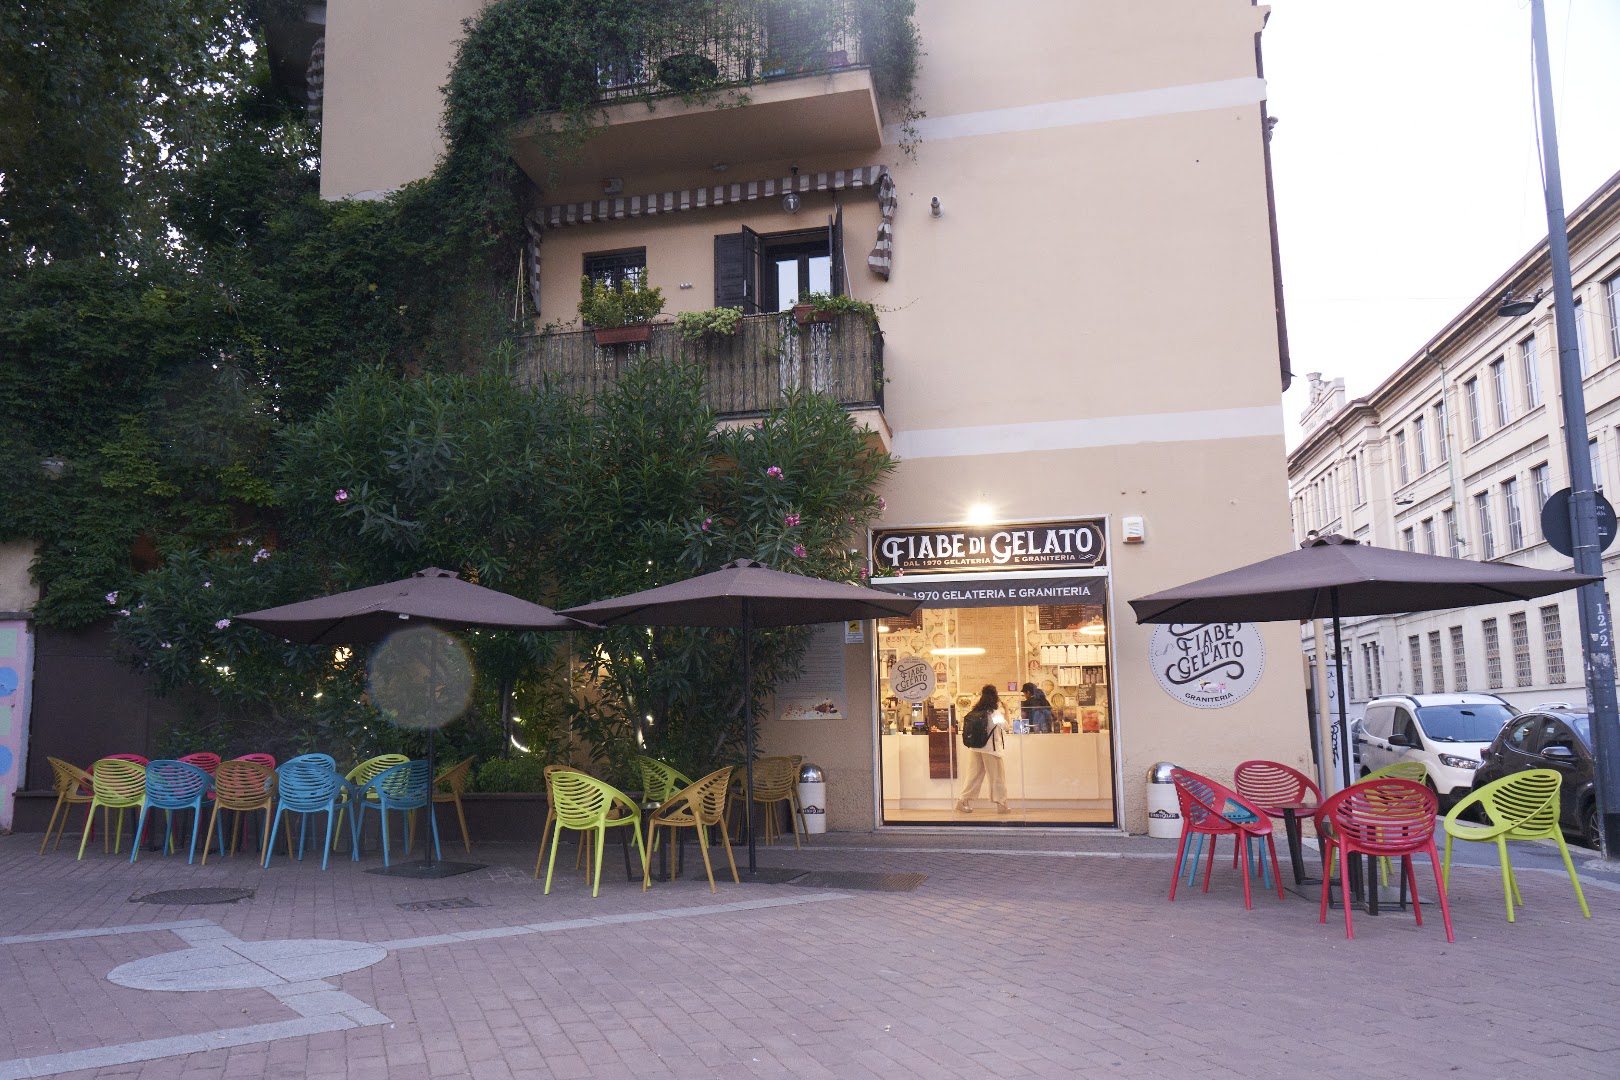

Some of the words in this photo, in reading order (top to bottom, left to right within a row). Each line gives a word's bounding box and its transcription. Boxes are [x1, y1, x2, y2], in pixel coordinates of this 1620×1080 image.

[882, 534, 965, 566] FIABE
[969, 536, 986, 554] DI
[990, 528, 1093, 563] GELATO
[913, 591, 940, 601] 1970
[942, 589, 1005, 600] GELATERIA
[1008, 589, 1016, 597] E
[1019, 587, 1091, 597] GRANITERIA
[1176, 623, 1235, 656] FIABE
[1177, 641, 1244, 679] GELATO
[1184, 692, 1234, 702] GRANITERIA
